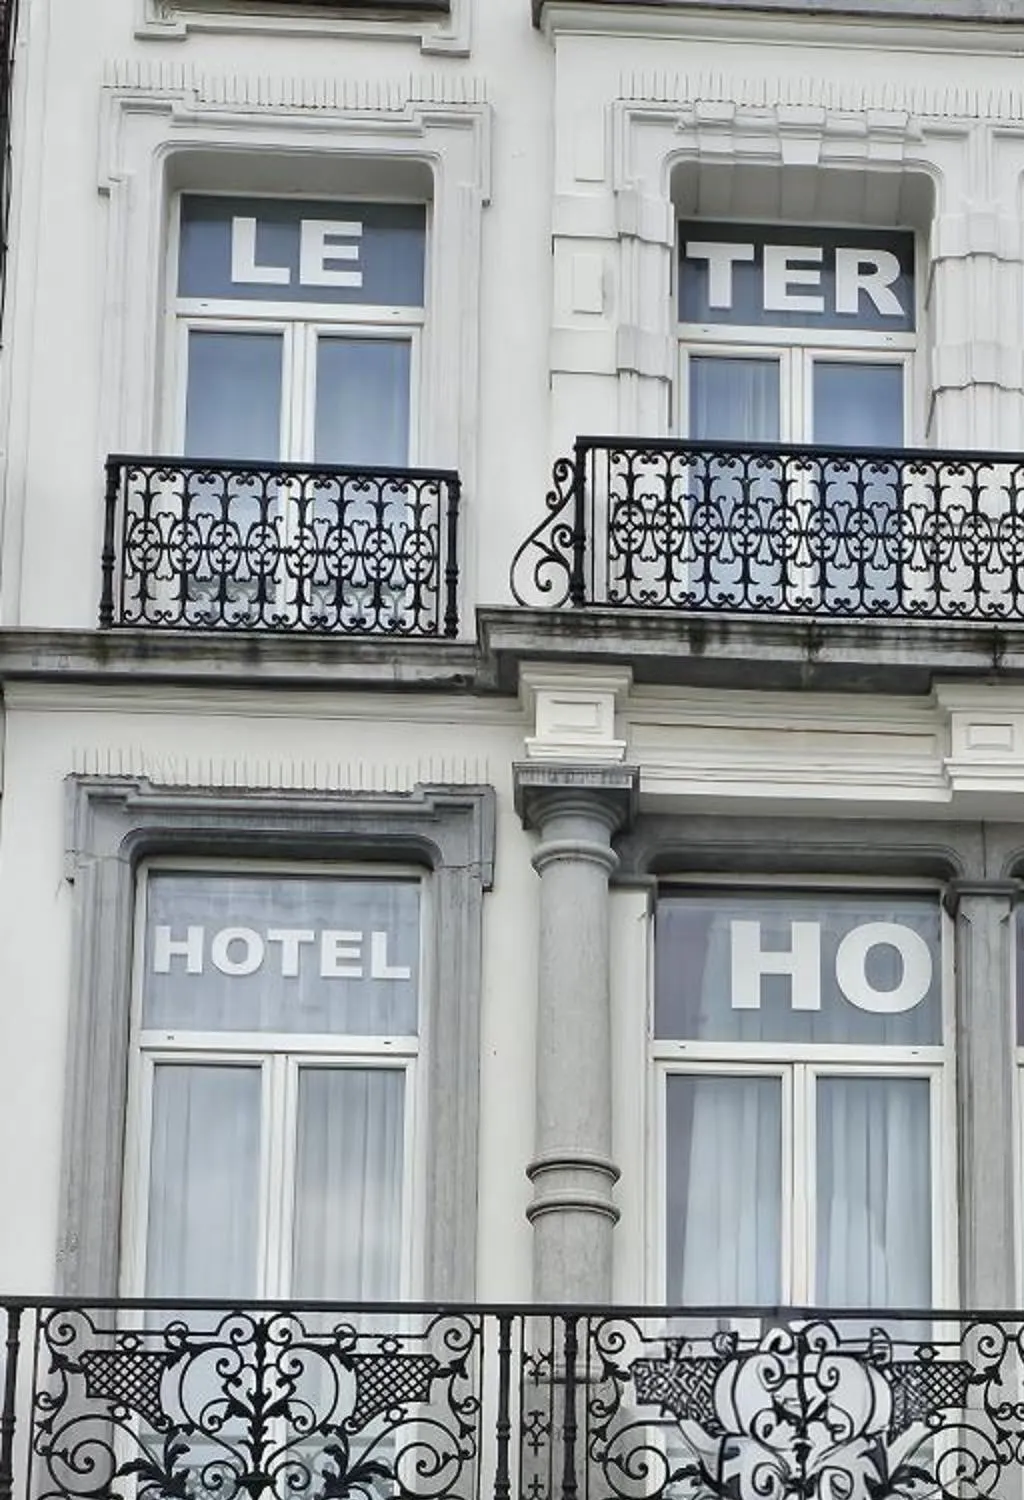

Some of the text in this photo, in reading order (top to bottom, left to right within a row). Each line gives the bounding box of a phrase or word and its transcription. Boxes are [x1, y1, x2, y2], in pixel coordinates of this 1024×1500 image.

[230, 215, 364, 288] LE
[684, 241, 906, 317] TER
[153, 925, 412, 980] HOTEL
[728, 919, 934, 1014] HO
